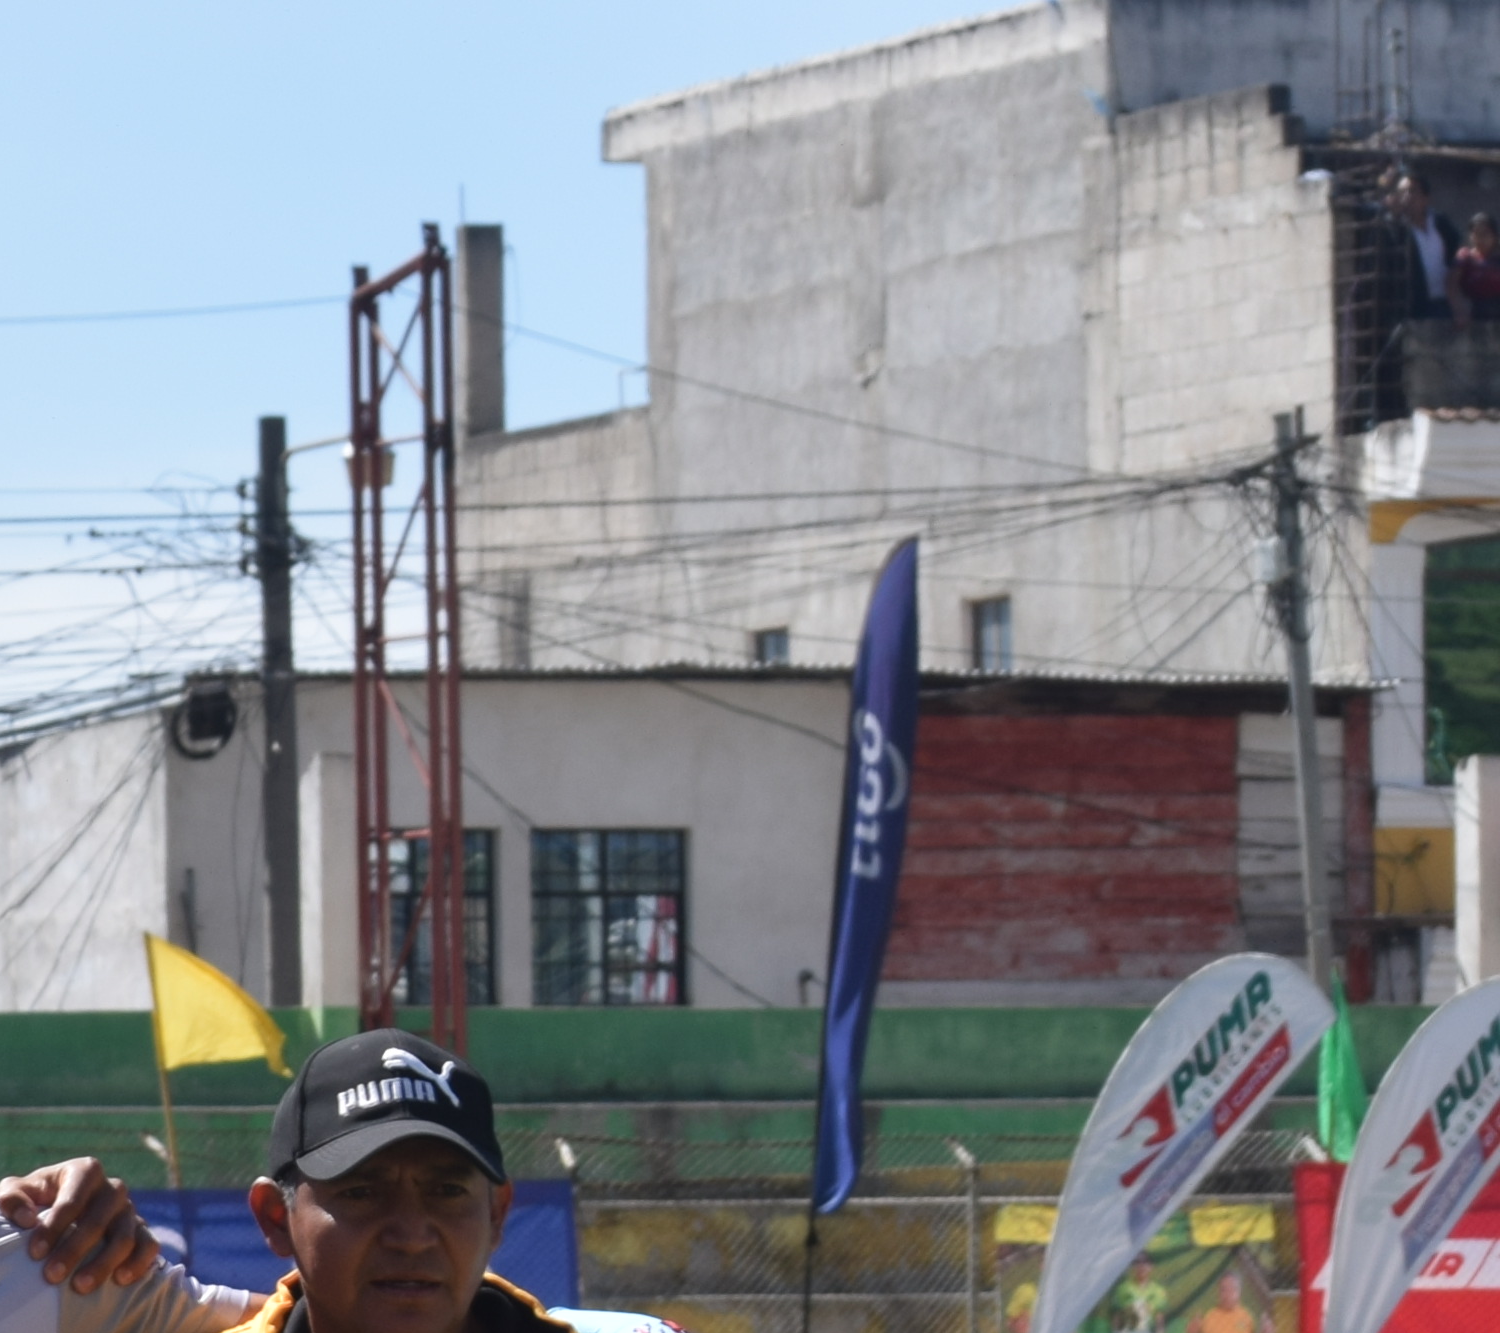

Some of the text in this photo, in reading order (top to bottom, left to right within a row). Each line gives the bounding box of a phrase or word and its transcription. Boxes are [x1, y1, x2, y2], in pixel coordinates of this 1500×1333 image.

[336, 1077, 438, 1119] PUMA
[1171, 971, 1272, 1108] PUMA
[1433, 1012, 1500, 1132] PUM
